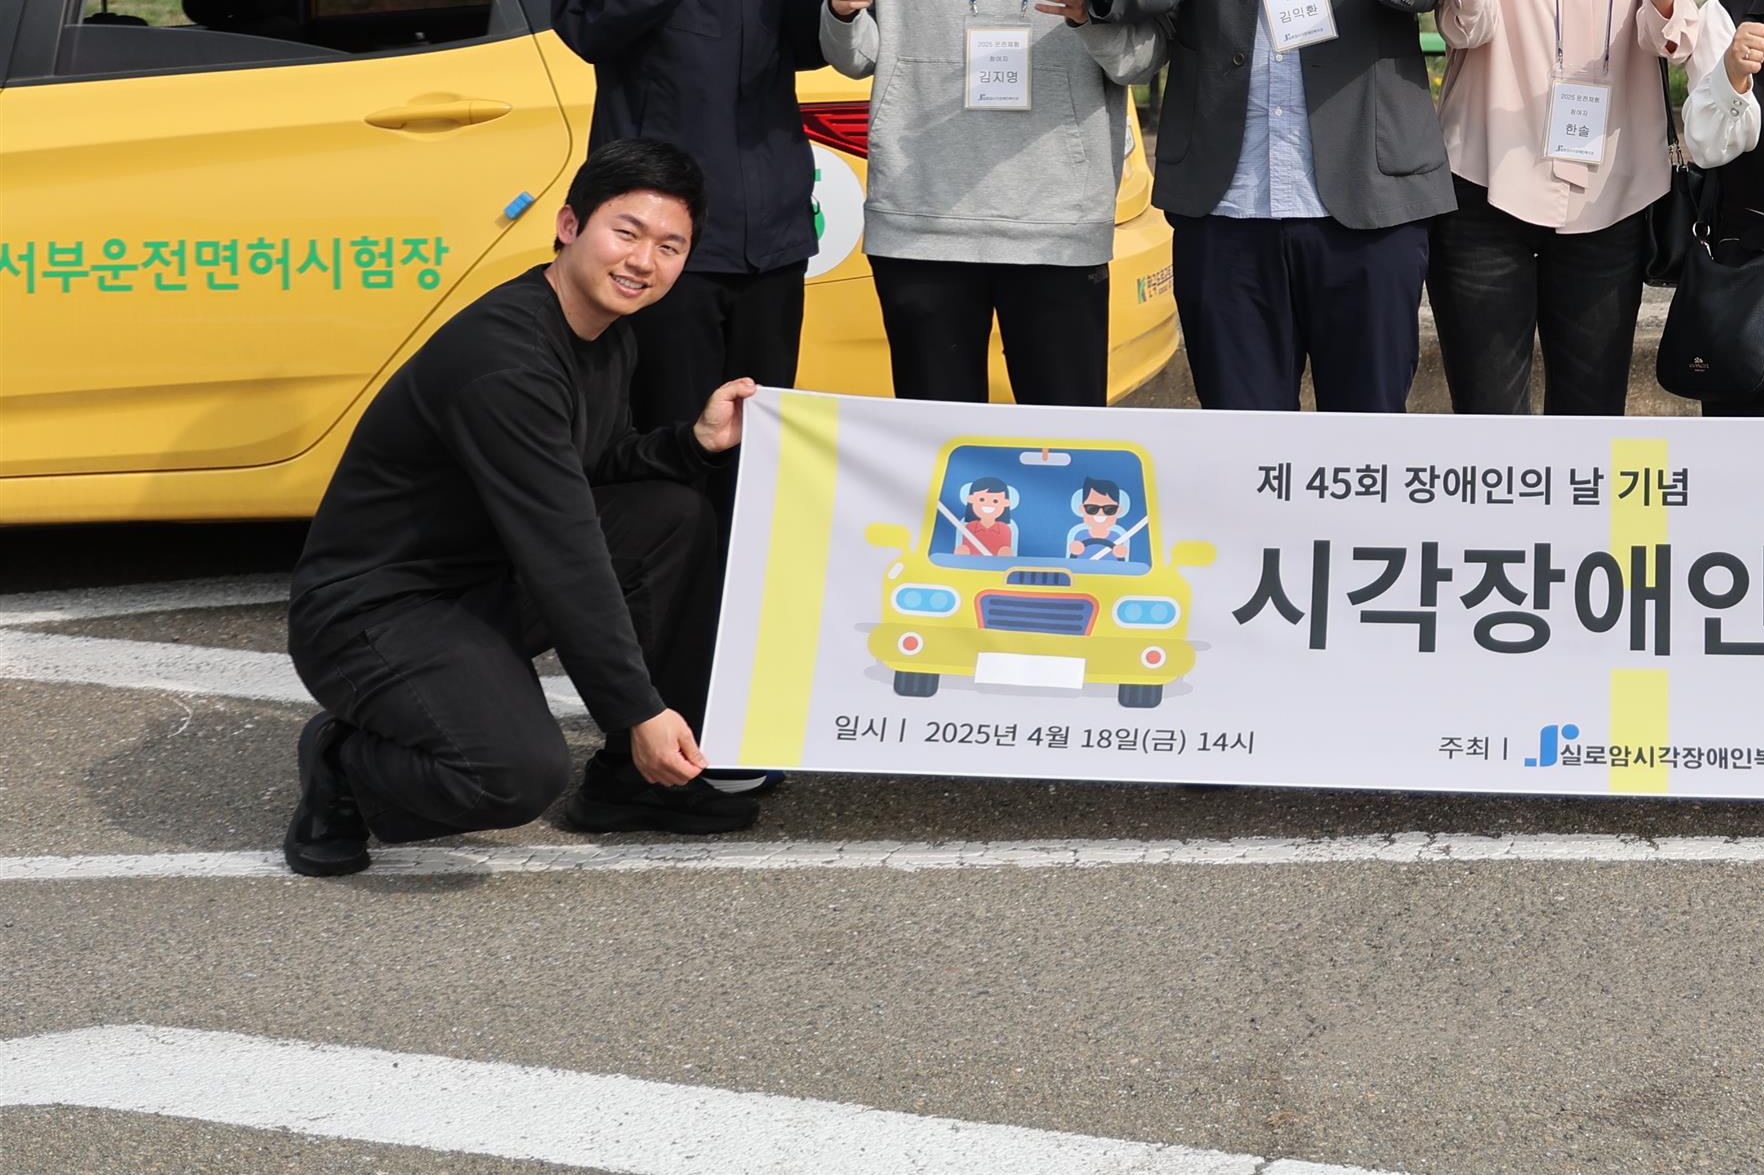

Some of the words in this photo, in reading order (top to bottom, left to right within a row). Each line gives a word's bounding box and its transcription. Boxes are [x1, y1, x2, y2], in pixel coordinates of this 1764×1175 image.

[0, 235, 450, 294] 서부운전면허시험장
[1256, 461, 1292, 501] 제
[1306, 464, 1389, 503] 45회
[1404, 465, 1552, 506] 장애인의
[1569, 467, 1605, 506] 날
[1617, 467, 1690, 506] 기념
[924, 720, 1018, 748] 2025년
[1026, 724, 1070, 750] 4월
[1080, 726, 1187, 755] 18일(금)
[1196, 729, 1256, 755] 14시
